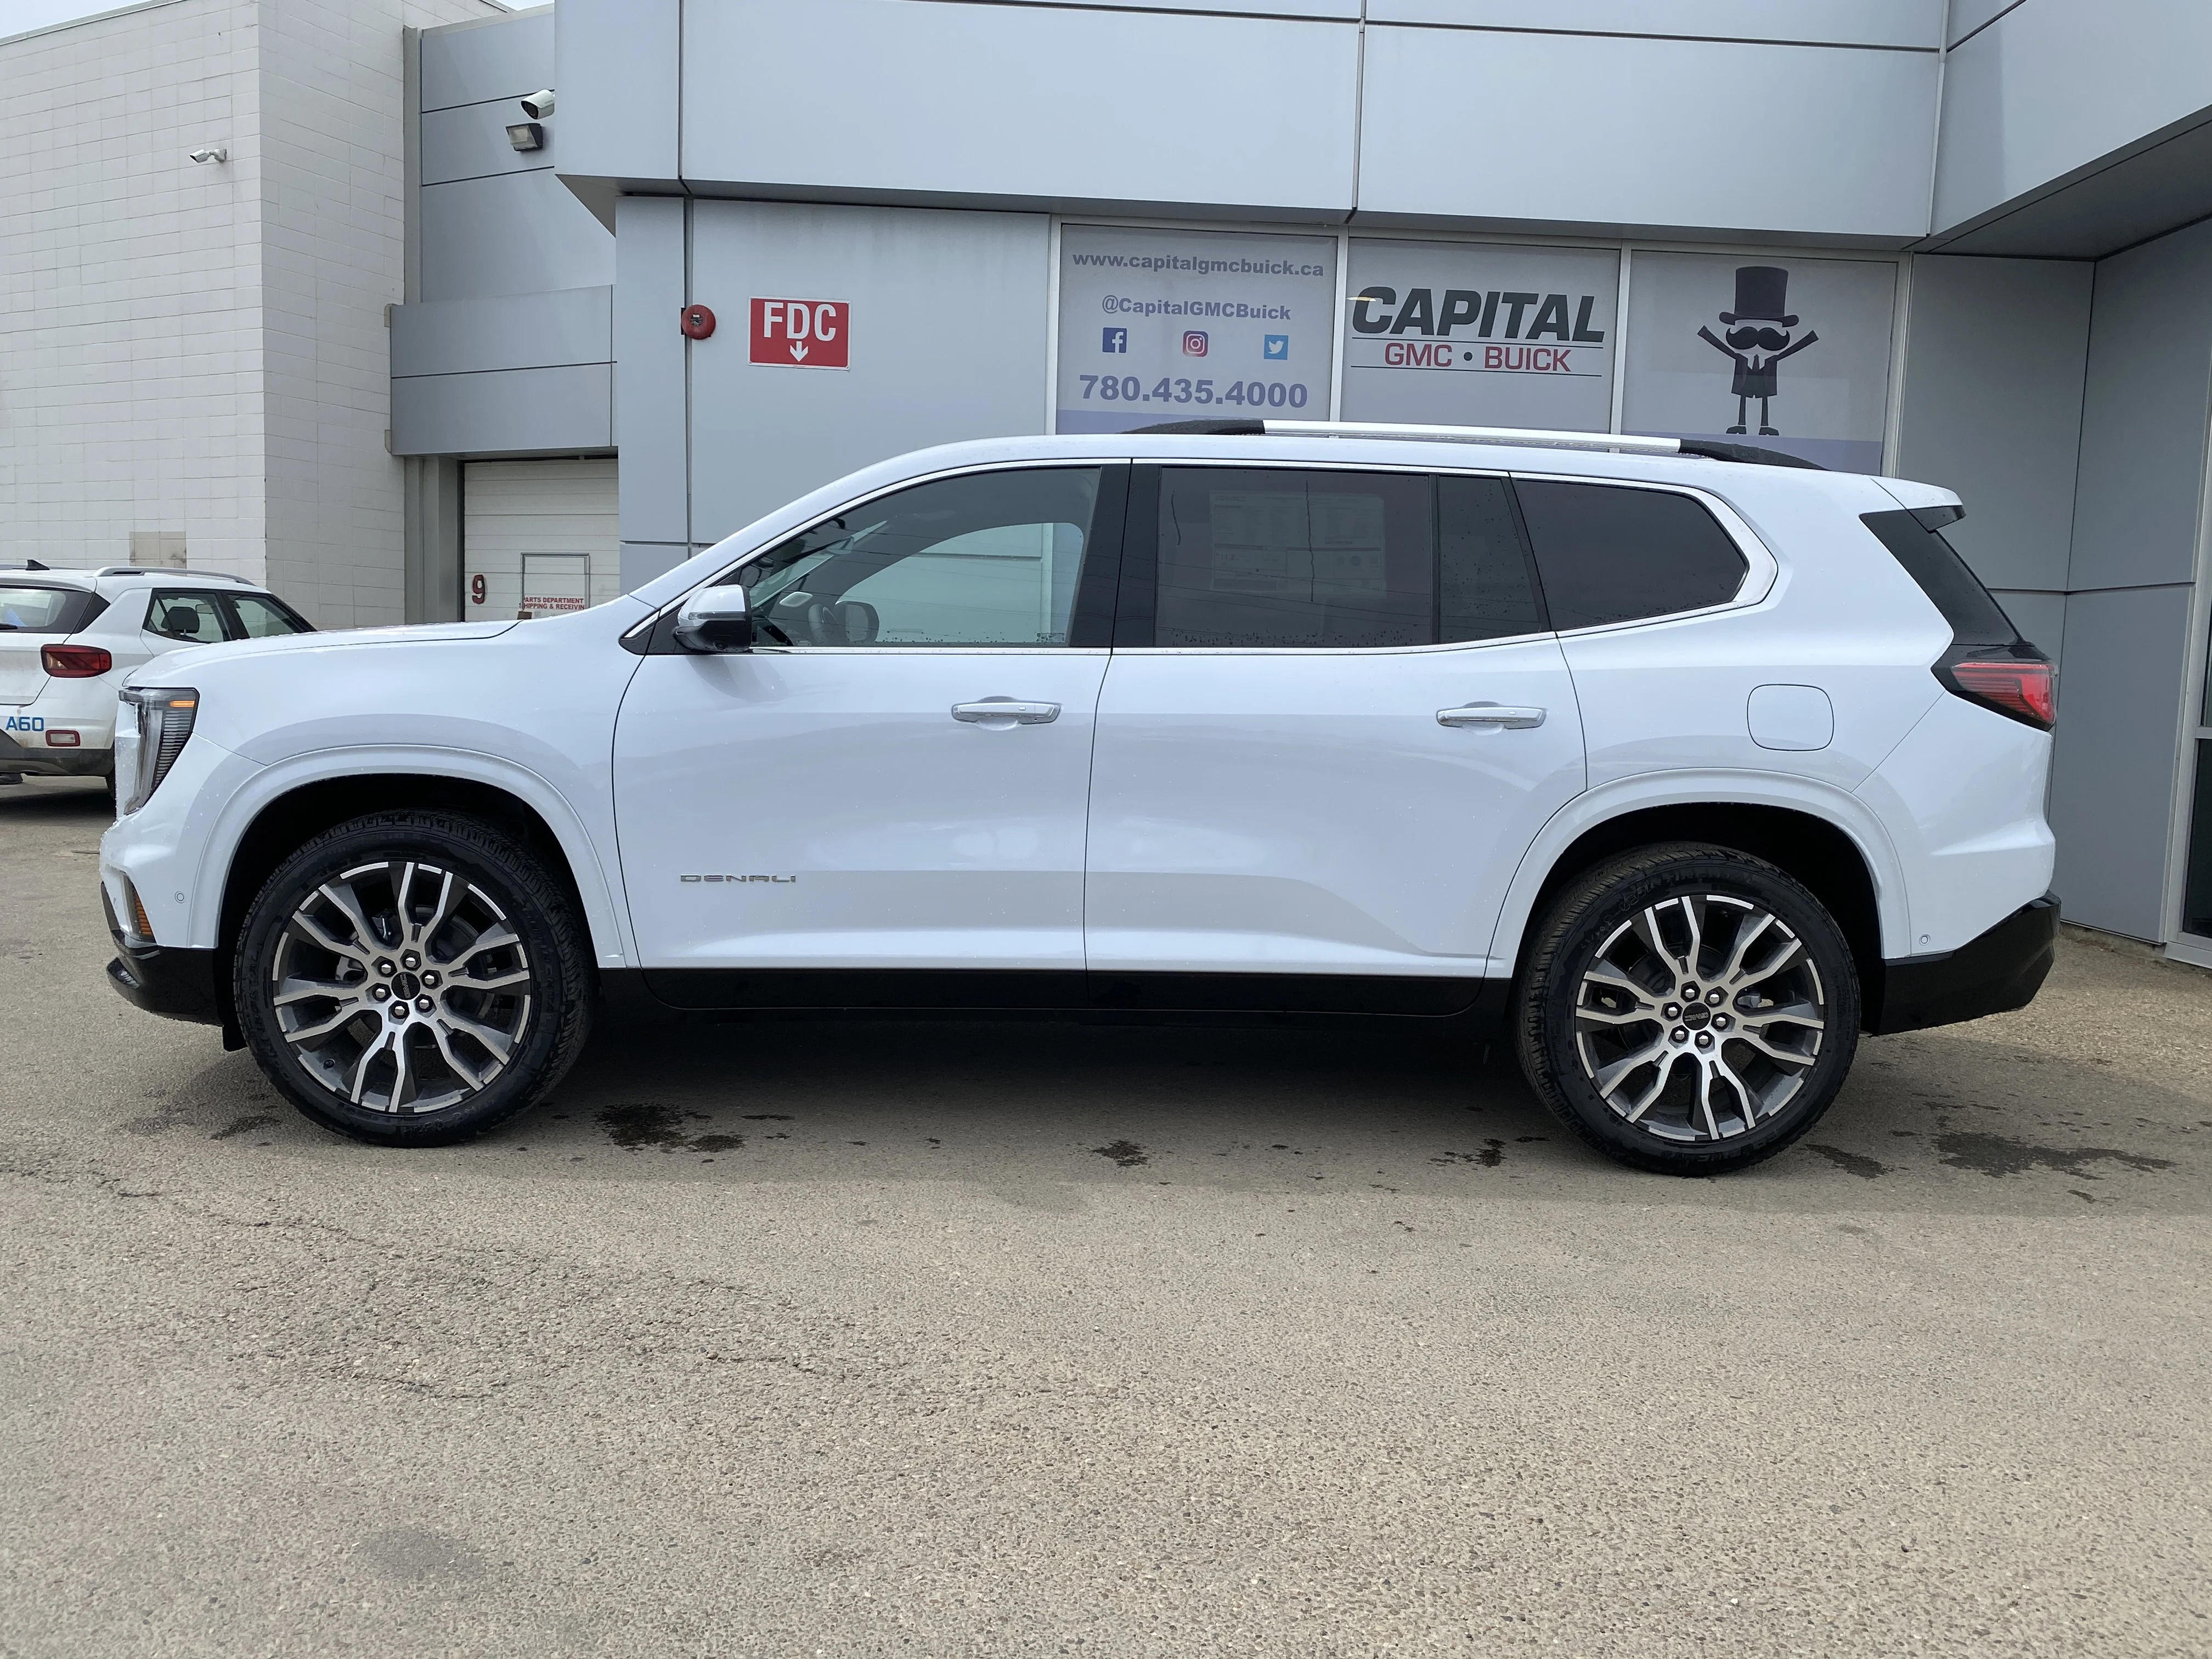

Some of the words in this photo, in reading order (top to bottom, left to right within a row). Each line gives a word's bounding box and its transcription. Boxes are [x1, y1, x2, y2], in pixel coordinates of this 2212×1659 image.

[1073, 254, 1324, 276] www.capitalgmcbuick.ca
[764, 302, 836, 341] FDC
[1102, 295, 1291, 320] @CapitalGMCBuick
[1352, 286, 1605, 343] CAPITAL
[1385, 343, 1452, 367] GMC
[1485, 346, 1571, 371] BUICK
[1080, 375, 1308, 408] 780.435.4000
[472, 574, 485, 605] 9
[5, 716, 44, 731] A60
